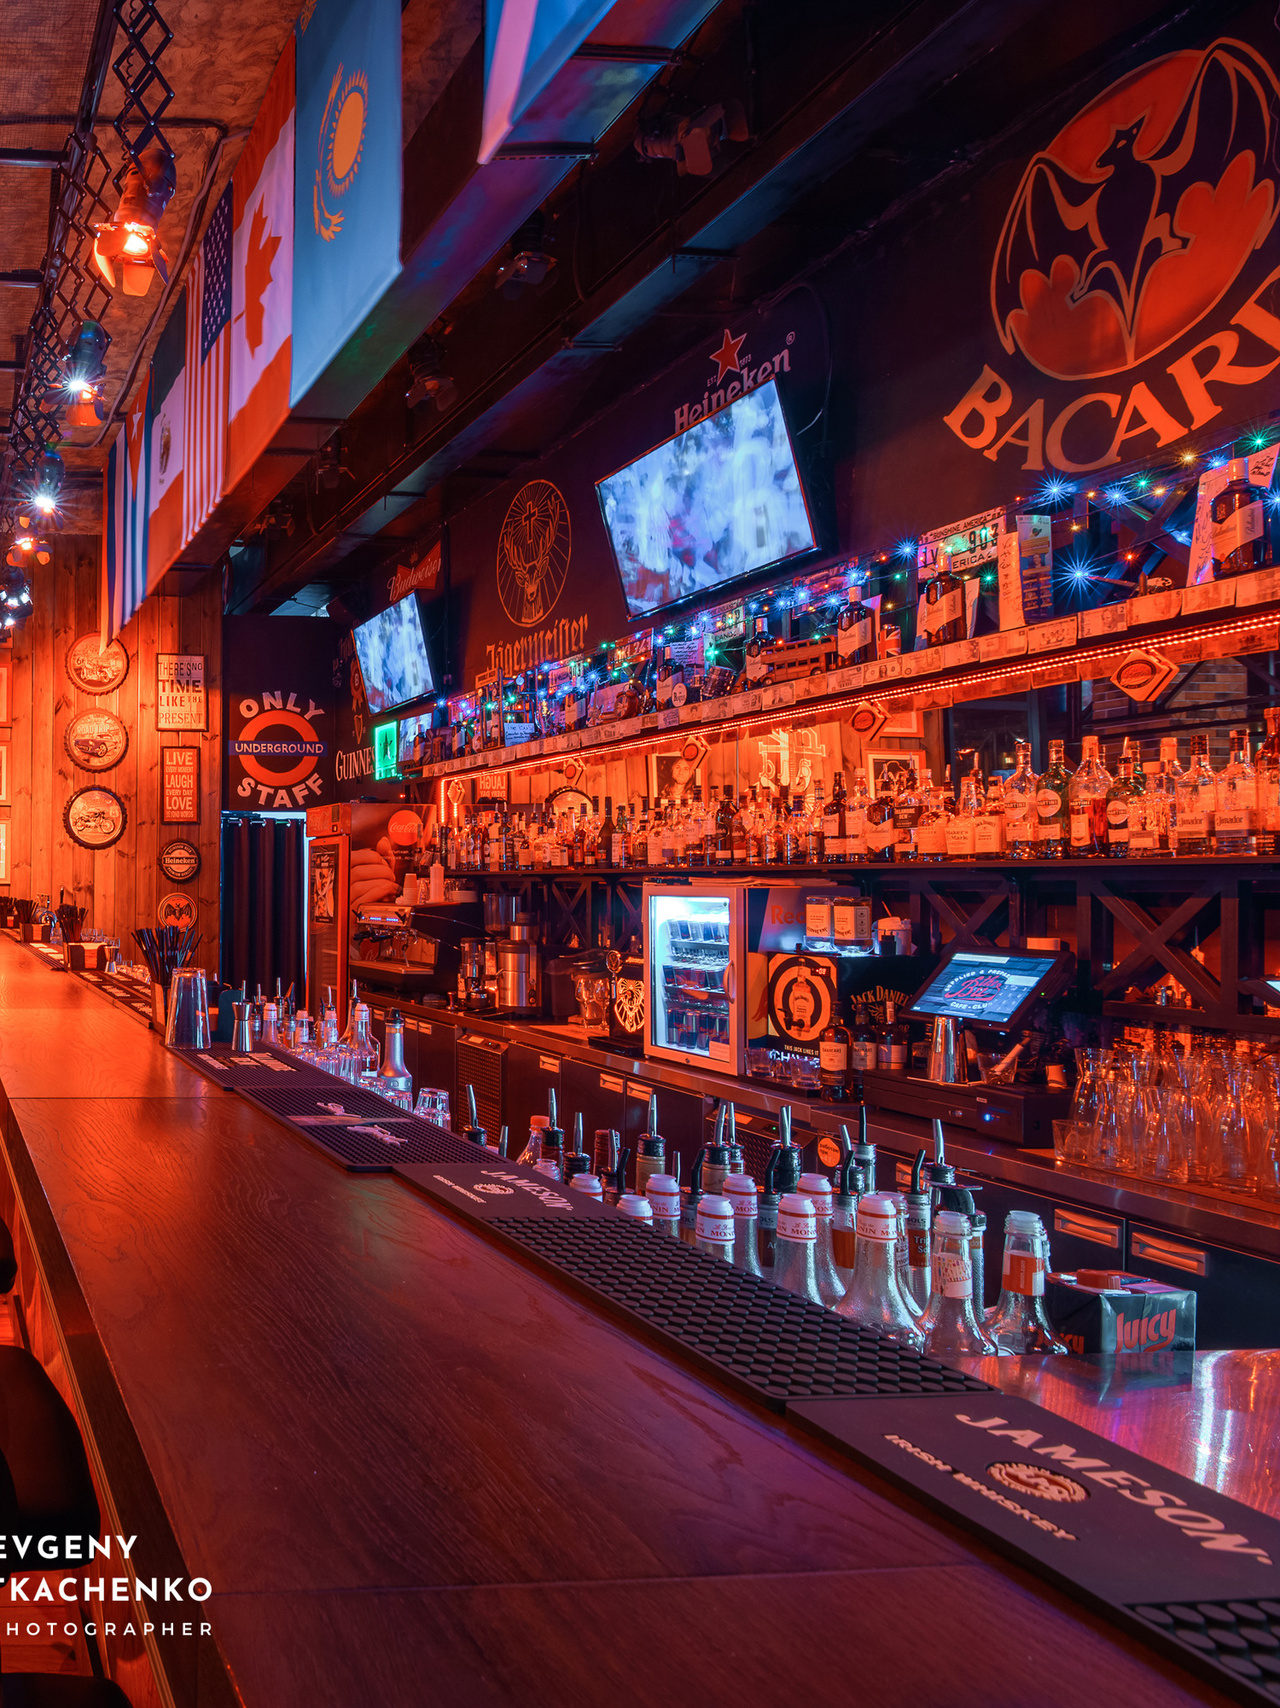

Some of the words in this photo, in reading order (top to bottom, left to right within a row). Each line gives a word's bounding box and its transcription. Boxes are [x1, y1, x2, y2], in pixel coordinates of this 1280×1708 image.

[707, 375, 718, 387] EST
[673, 347, 791, 434] Heineken
[158, 662, 191, 676] THERE'S
[192, 663, 202, 671] NO
[158, 680, 202, 693] TIME
[160, 696, 185, 707] LIKE
[240, 691, 325, 720] ONLY
[159, 712, 203, 724] PRESENT
[235, 743, 324, 753] UNDERGROUND
[166, 752, 193, 765] LIVE
[335, 745, 375, 781] GUINNES
[166, 775, 193, 788] LAUGH
[237, 772, 324, 808] STAFF
[166, 797, 193, 810] LOVE
[850, 991, 875, 1005] JACK
[480, 1169, 573, 1212] JAMESON
[1114, 1308, 1177, 1353] Juicy
[884, 1433, 955, 1473] IRISH
[952, 1471, 1080, 1542] WHISKEY
[954, 1413, 1274, 1566] JAMESON
